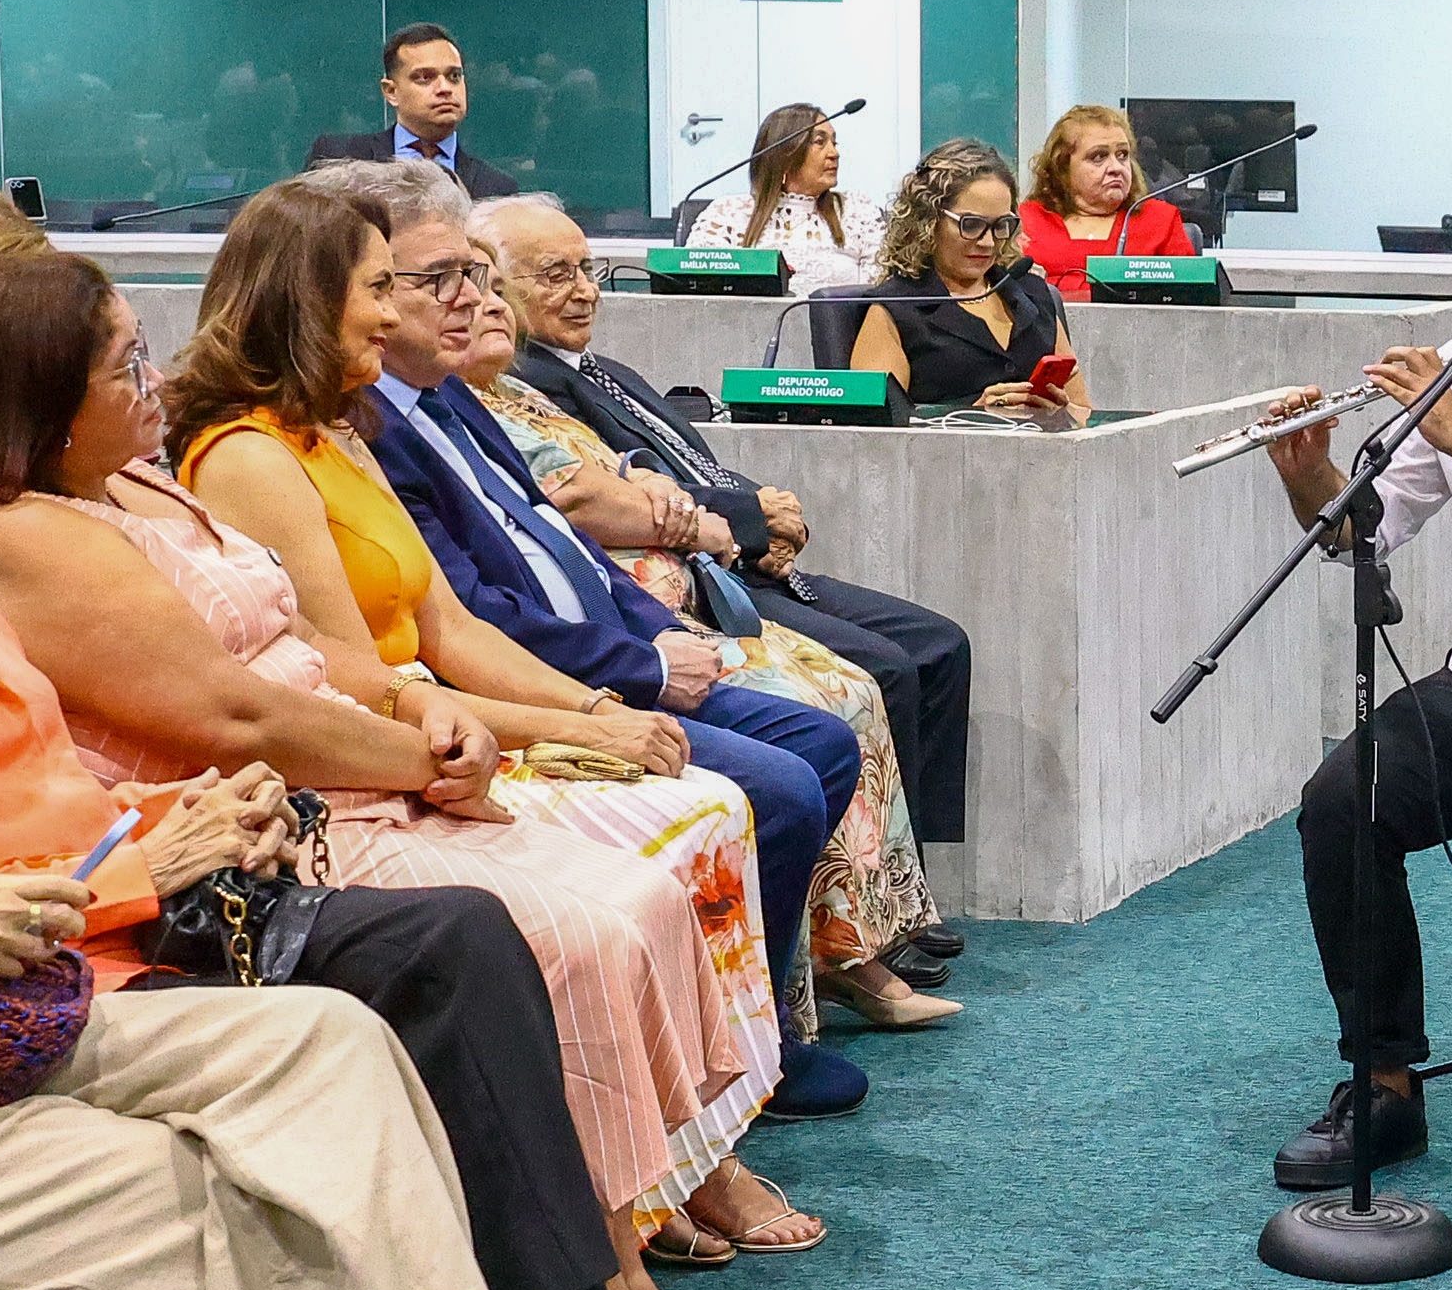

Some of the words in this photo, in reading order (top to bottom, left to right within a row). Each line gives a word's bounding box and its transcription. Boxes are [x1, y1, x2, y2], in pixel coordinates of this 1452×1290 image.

[689, 251, 732, 260] DEPUTADA
[680, 261, 708, 269] EMÍLIA
[709, 261, 740, 270] PESSOA
[1129, 261, 1171, 269] DEPUTADA
[1141, 271, 1175, 279] SILVANA
[778, 377, 829, 386] DEPUTADO
[761, 387, 813, 397] FERNANDO
[815, 388, 844, 397] HUGO
[1358, 689, 1367, 722] SATY
